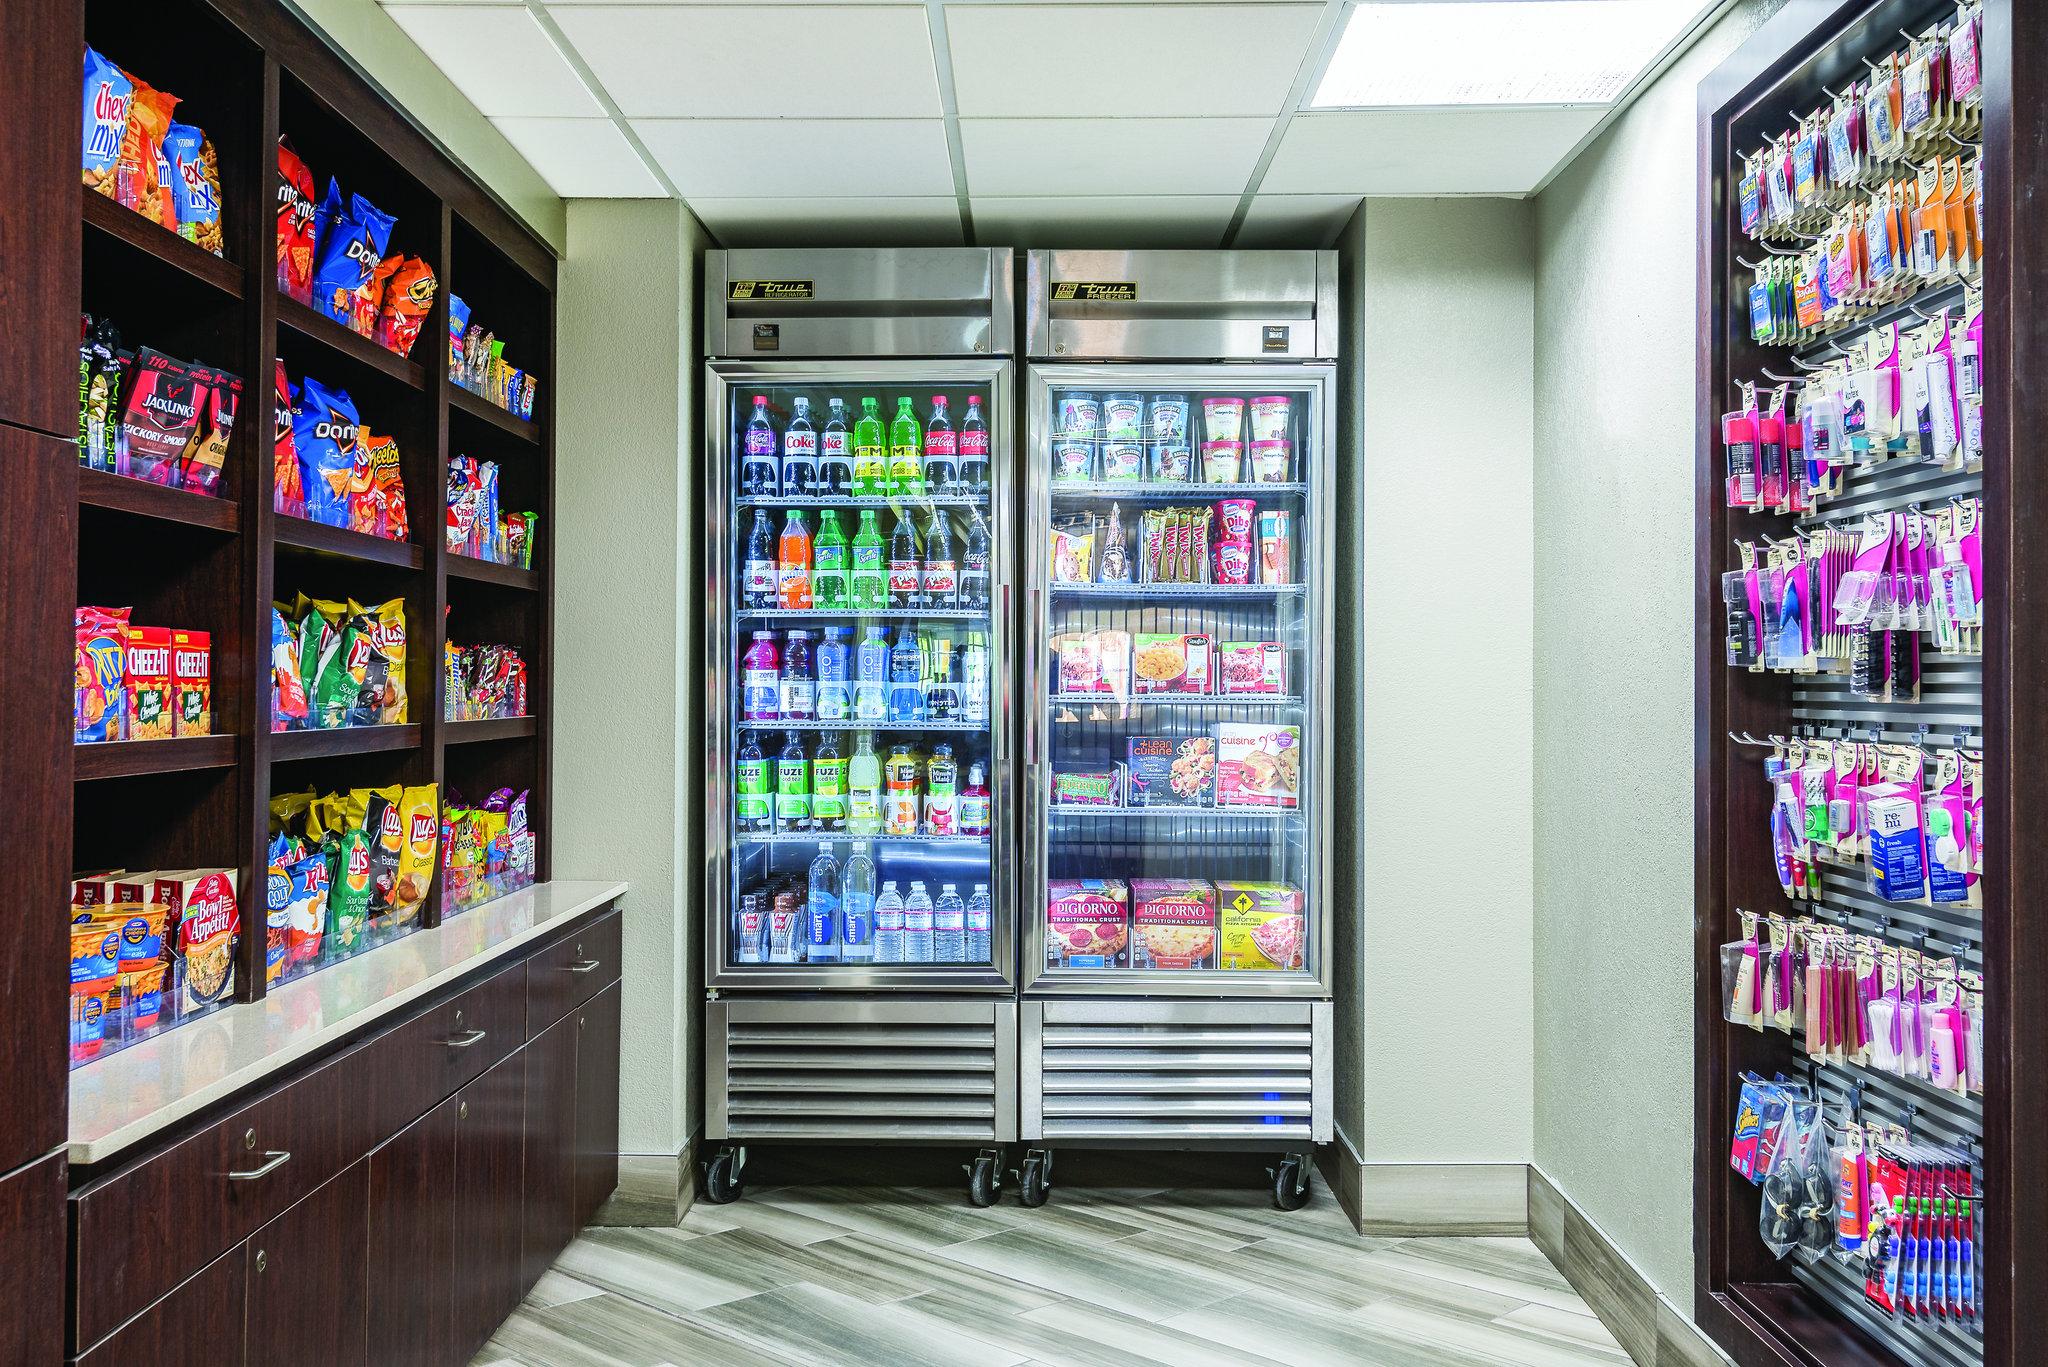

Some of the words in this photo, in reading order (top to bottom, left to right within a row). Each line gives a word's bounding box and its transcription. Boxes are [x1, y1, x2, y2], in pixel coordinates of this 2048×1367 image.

[94, 80, 131, 123] Chex
[86, 123, 123, 162] mix
[758, 282, 808, 292] true
[1081, 283, 1132, 293] true
[1795, 283, 1817, 299] DayQuil
[149, 355, 169, 370] 110
[123, 422, 162, 442] HICKORY
[786, 436, 815, 449] Coke
[822, 437, 842, 449] oke
[1226, 515, 1249, 527] Dibs
[1166, 527, 1176, 556] TWIX
[1179, 522, 1190, 556] TWIX
[1192, 523, 1205, 557] TWIX
[859, 551, 878, 564] Sprite
[1224, 558, 1247, 571] Dibs
[127, 647, 170, 677] CHEEZ-IT
[175, 650, 209, 679] CHEEZ-IT
[1221, 737, 1256, 746] cuisine
[779, 768, 803, 776] FUZE
[815, 767, 839, 776] FUZE
[1885, 812, 1901, 821] re-
[411, 814, 437, 842] Lay's
[1885, 820, 1901, 829] nu
[381, 855, 399, 866] Barbe
[199, 895, 223, 922] Bowl
[1225, 915, 1262, 923] california
[190, 911, 230, 943] Appétit!
[131, 950, 148, 958] easy
